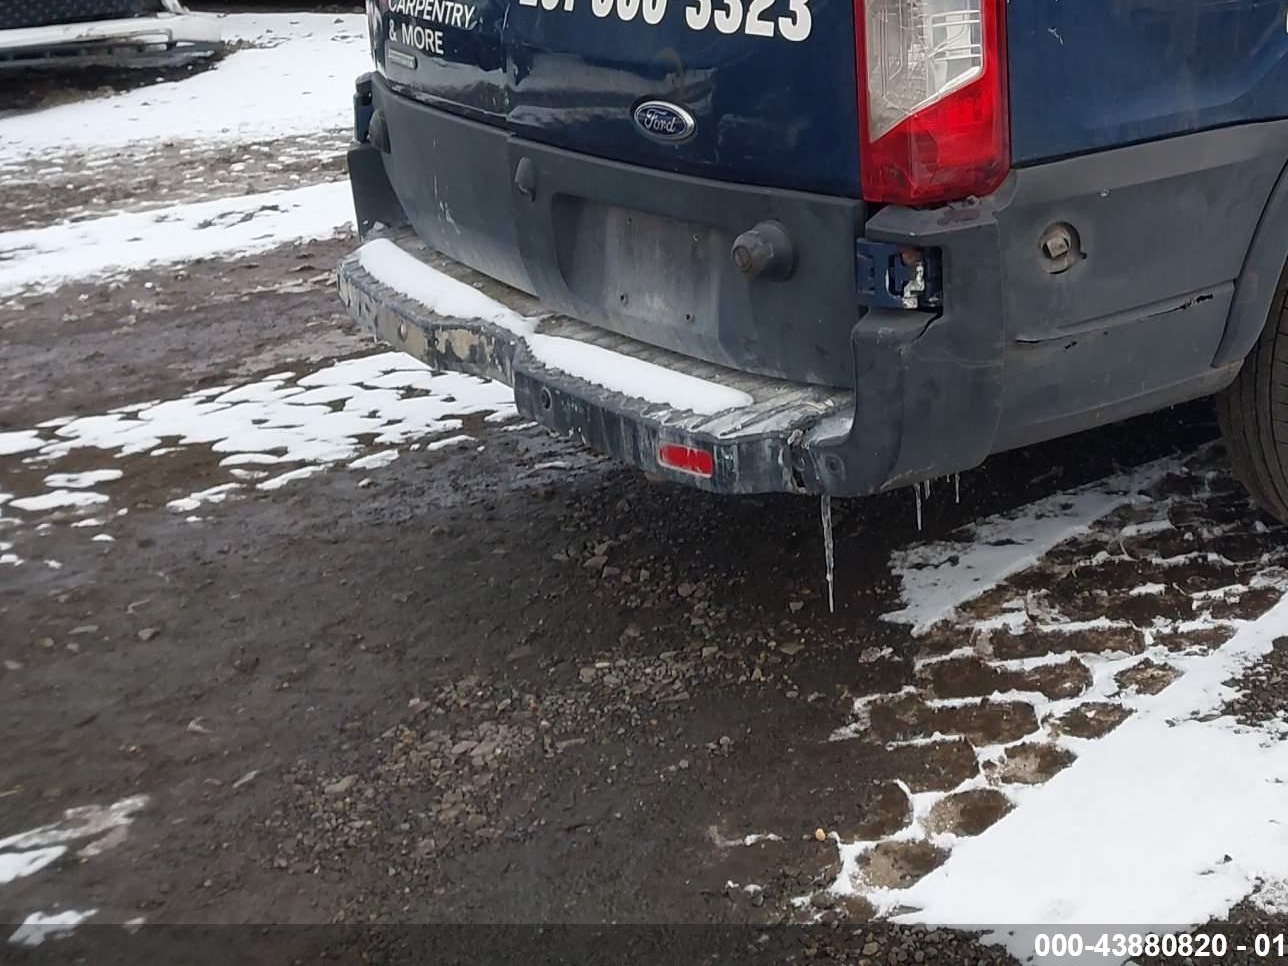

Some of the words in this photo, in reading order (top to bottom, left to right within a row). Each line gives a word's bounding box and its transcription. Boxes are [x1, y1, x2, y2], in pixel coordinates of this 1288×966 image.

[388, 22, 397, 42] &
[401, 26, 445, 55] MORE
[644, 108, 676, 132] Ford
